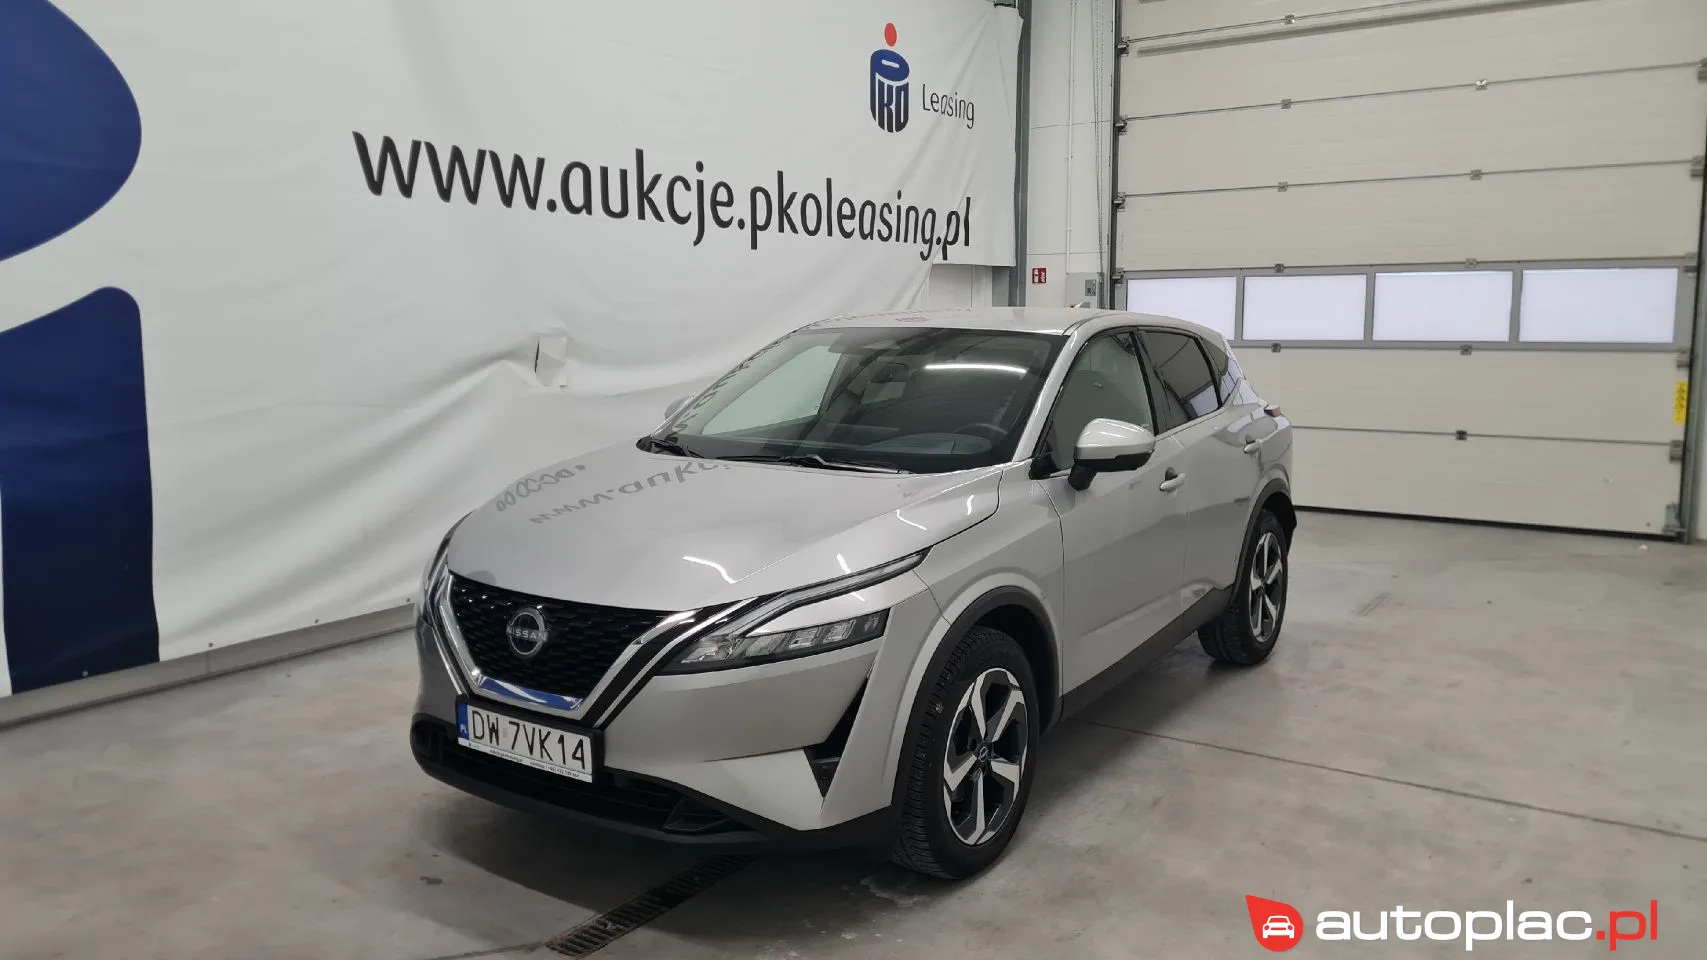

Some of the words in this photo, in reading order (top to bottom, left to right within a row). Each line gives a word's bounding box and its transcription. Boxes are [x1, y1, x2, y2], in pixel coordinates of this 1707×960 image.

[922, 83, 976, 130] Leasing
[352, 130, 971, 261] www.aukcje.pkoleasing.pl
[506, 625, 548, 642] NISSAN
[472, 710, 500, 746] DW
[508, 720, 586, 771] 7VK14
